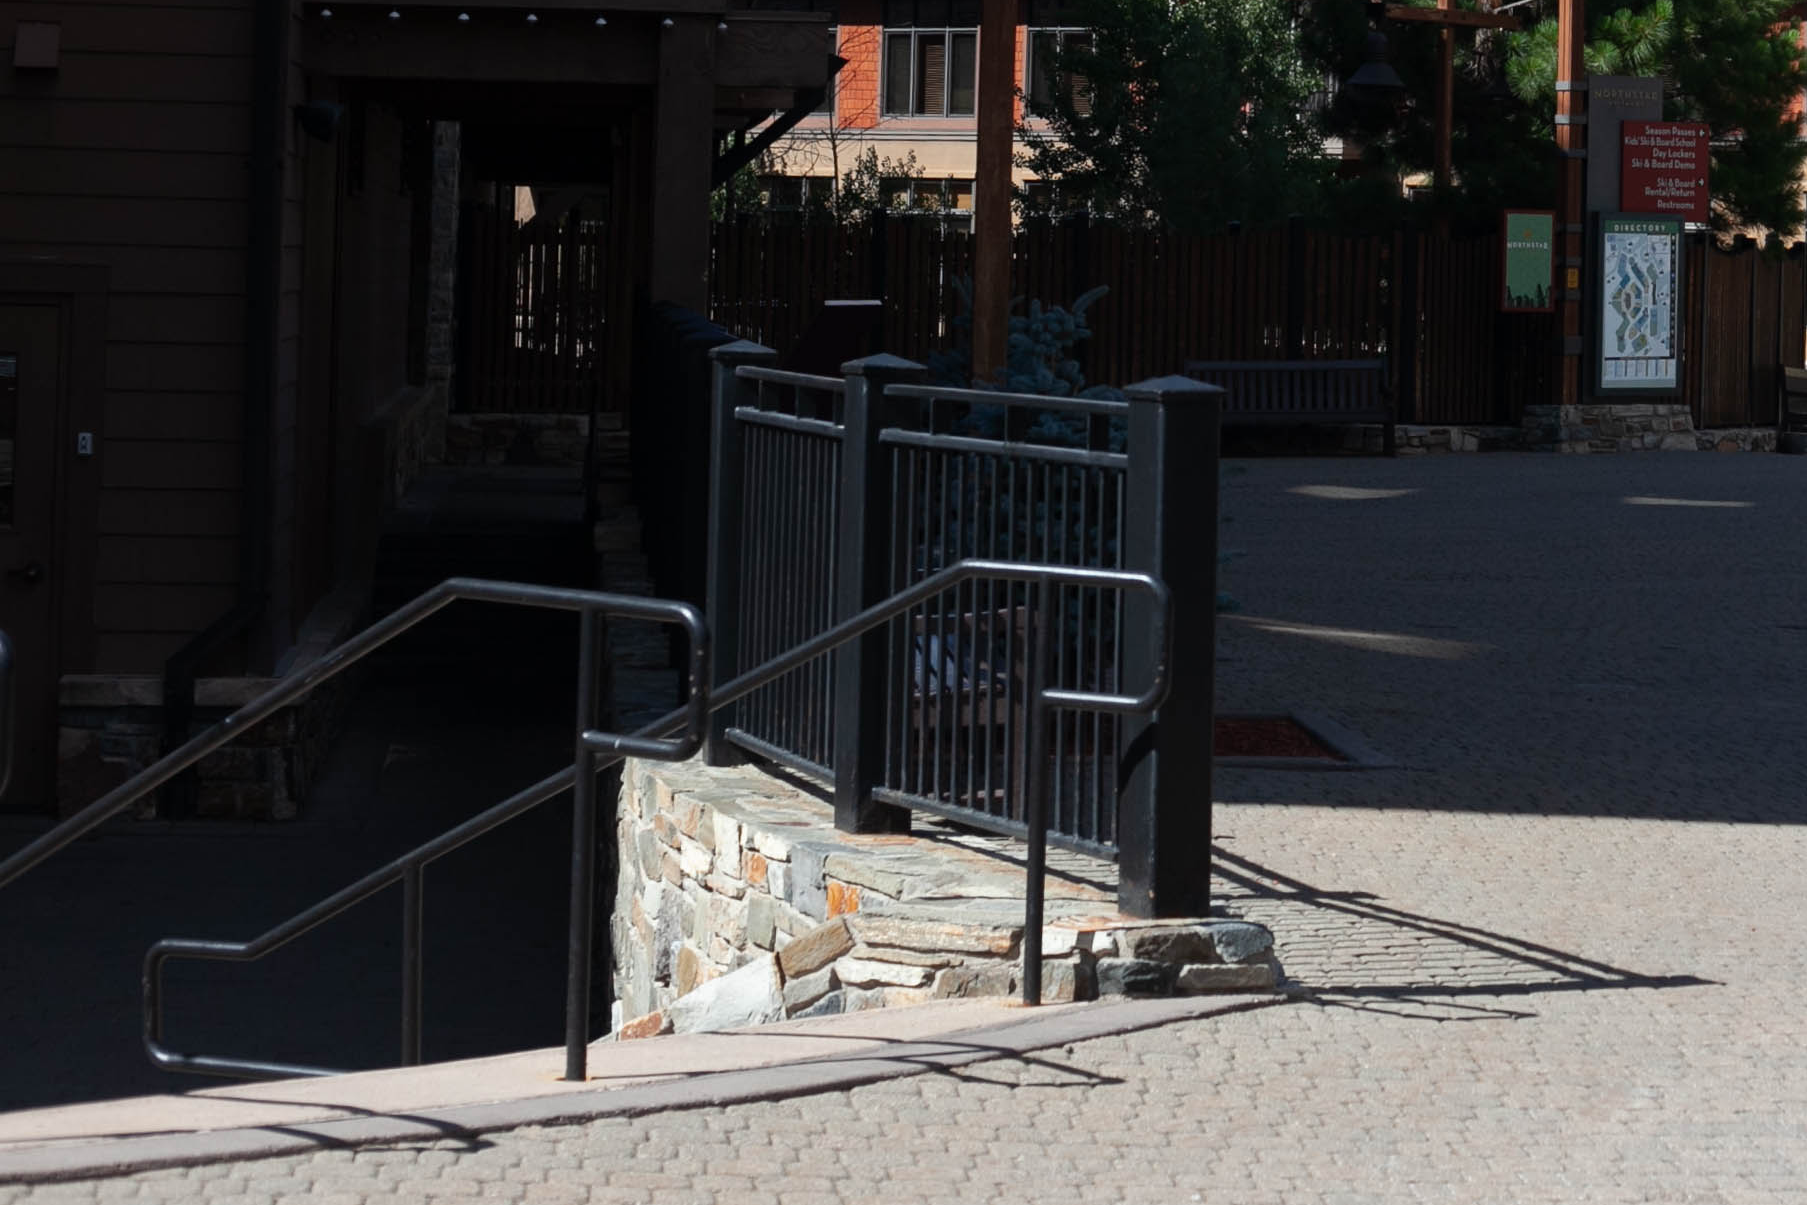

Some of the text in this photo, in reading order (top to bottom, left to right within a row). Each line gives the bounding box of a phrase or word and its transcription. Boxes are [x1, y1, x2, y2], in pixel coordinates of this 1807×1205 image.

[1645, 126, 1696, 136] Season Passes
[1675, 138, 1696, 148] School
[1653, 147, 1696, 159] Day Lockers
[1631, 157, 1643, 168] Ski
[1651, 159, 1674, 169] Board
[1674, 160, 1696, 170] Demo
[1657, 177, 1667, 187] Ski
[1674, 178, 1696, 188] Board
[1657, 199, 1695, 210] Restrooms
[1614, 224, 1666, 232] DIRECTORY
